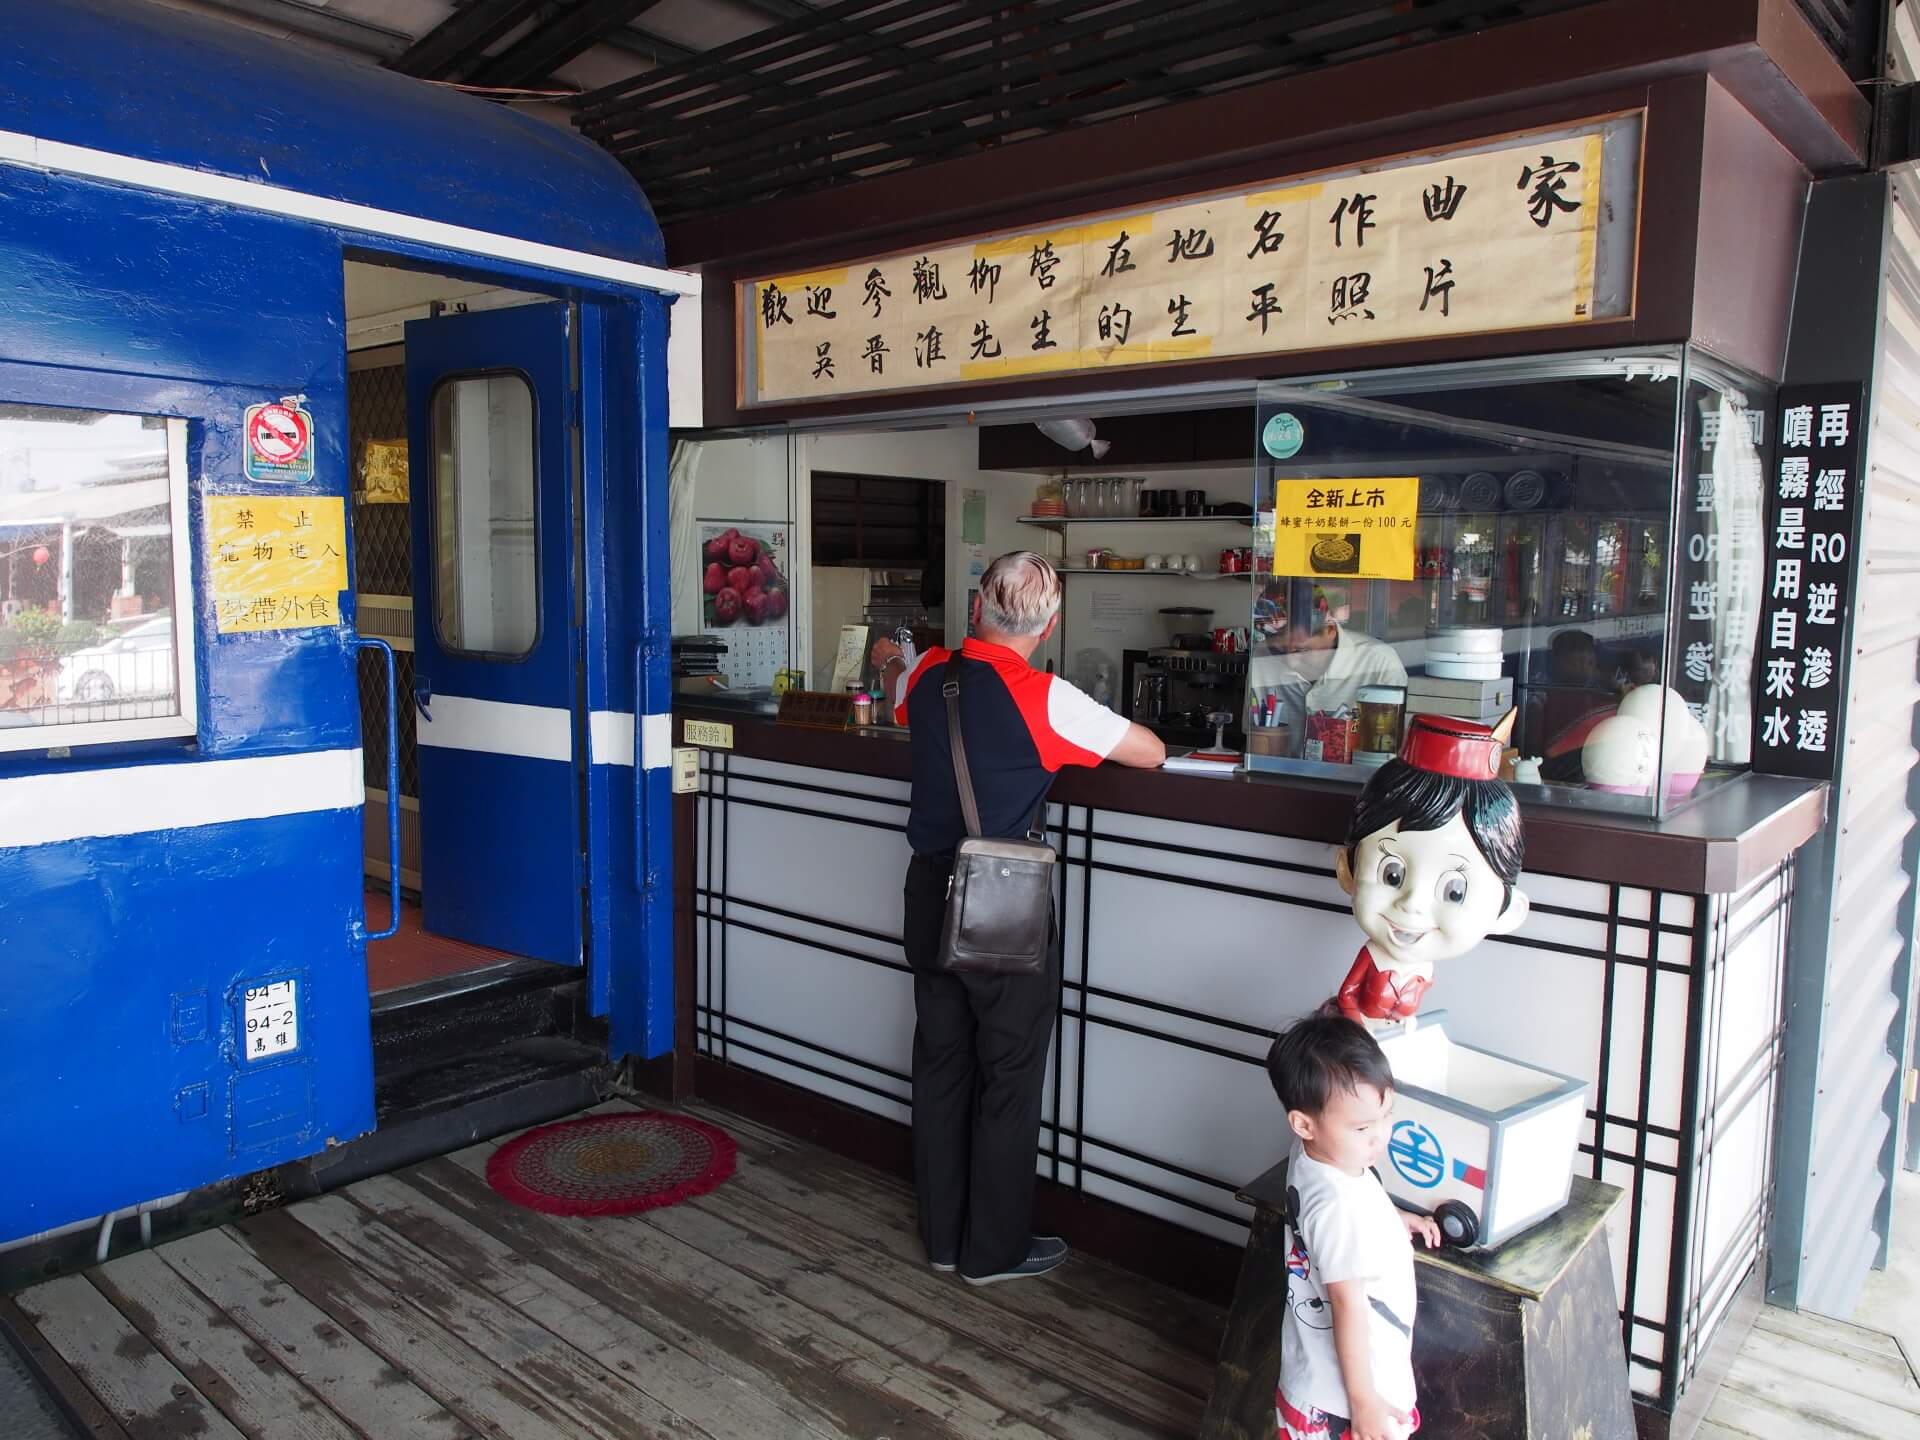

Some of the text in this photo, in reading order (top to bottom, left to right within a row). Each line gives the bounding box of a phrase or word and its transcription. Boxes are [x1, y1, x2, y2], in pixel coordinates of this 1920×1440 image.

[761, 156, 1581, 328] 歡迎參觀柳營在地名作曲家
[812, 258, 1456, 379] 吳晉淮先生的生平照片
[1306, 488, 1385, 509] 全新上市
[1378, 516, 1396, 528] 100
[1400, 517, 1412, 528] 元
[1762, 405, 1813, 749] 噴霧是用自來水
[246, 980, 291, 1002] 94-1
[247, 1010, 293, 1033] 94-2
